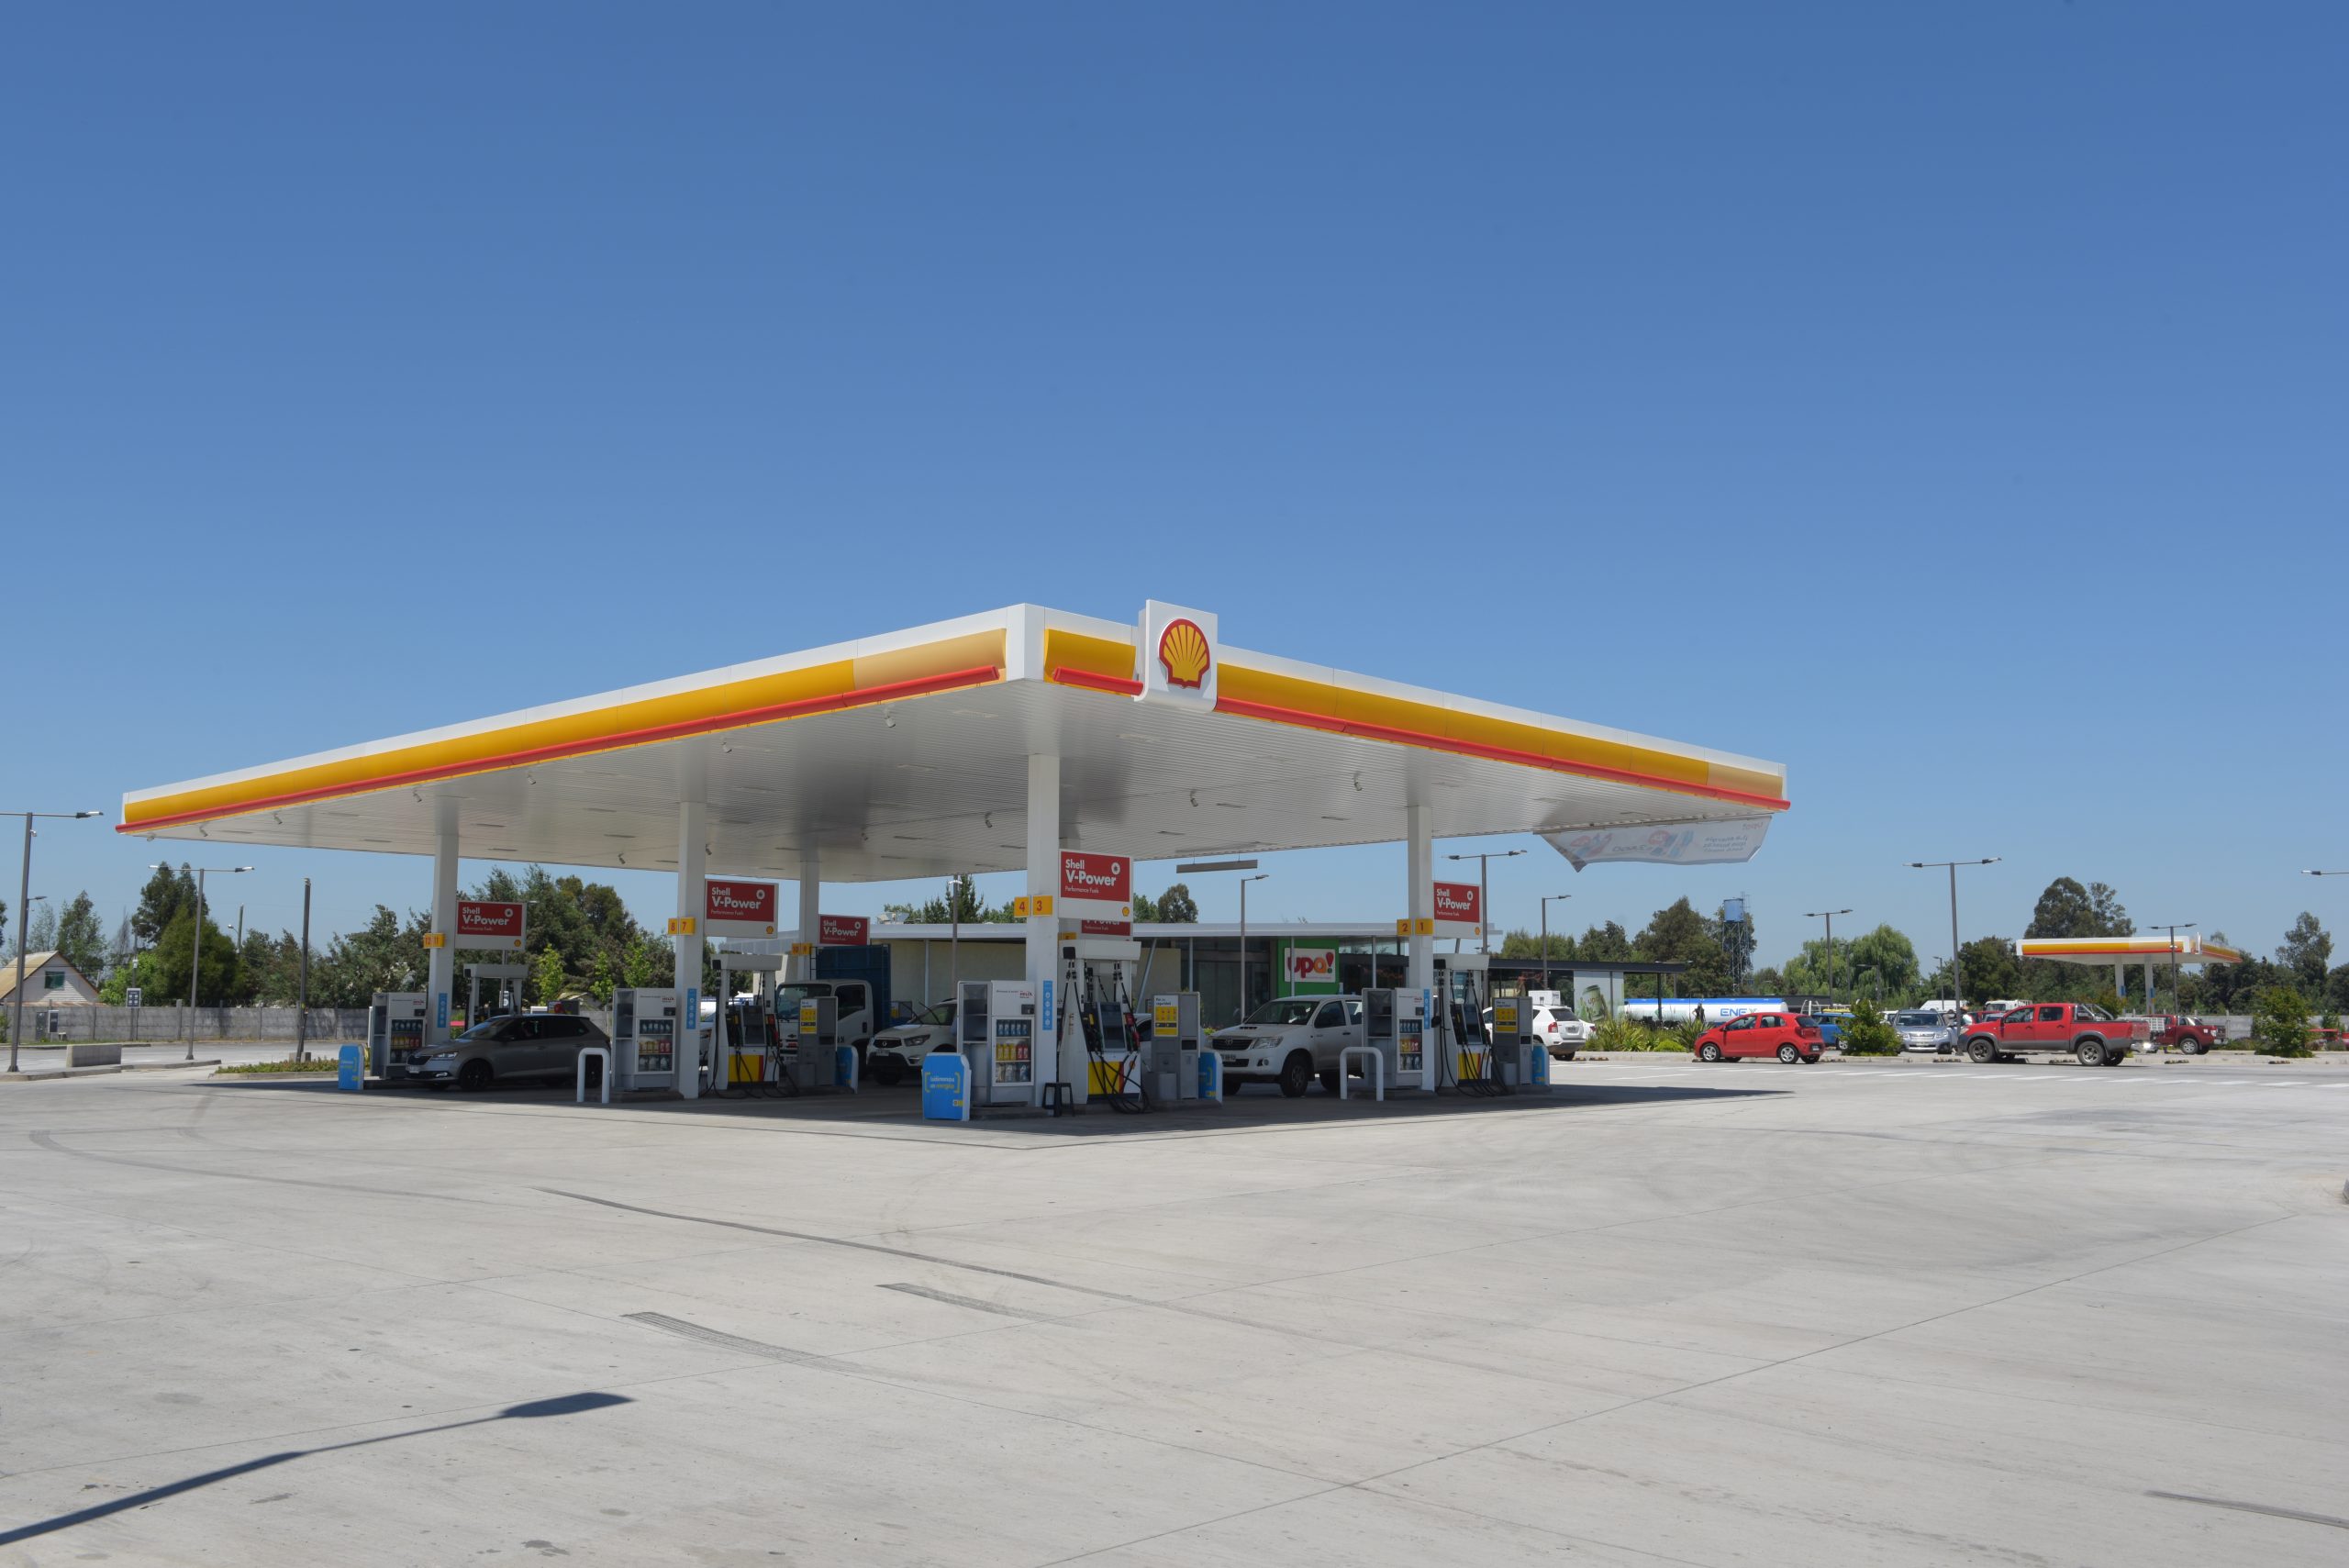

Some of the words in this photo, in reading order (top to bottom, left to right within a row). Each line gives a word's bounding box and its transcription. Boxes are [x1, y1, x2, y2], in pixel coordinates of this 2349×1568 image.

[1065, 858, 1085, 870] Shell
[1065, 869, 1117, 886] V-Power
[711, 886, 730, 896] Shell
[1436, 888, 1450, 897] Shell
[711, 895, 762, 910] V-Power
[1019, 901, 1026, 913] 4
[1036, 900, 1042, 912] 3
[1436, 896, 1471, 910] V-Power
[462, 906, 481, 915] Shell
[462, 914, 510, 926] V-Power
[671, 921, 675, 932] 8
[682, 921, 687, 932] 7
[823, 926, 859, 937] V-Power
[1401, 922, 1408, 932] 2
[1419, 921, 1424, 931] 1
[793, 946, 799, 954] 10
[1287, 951, 1334, 979] upa!
